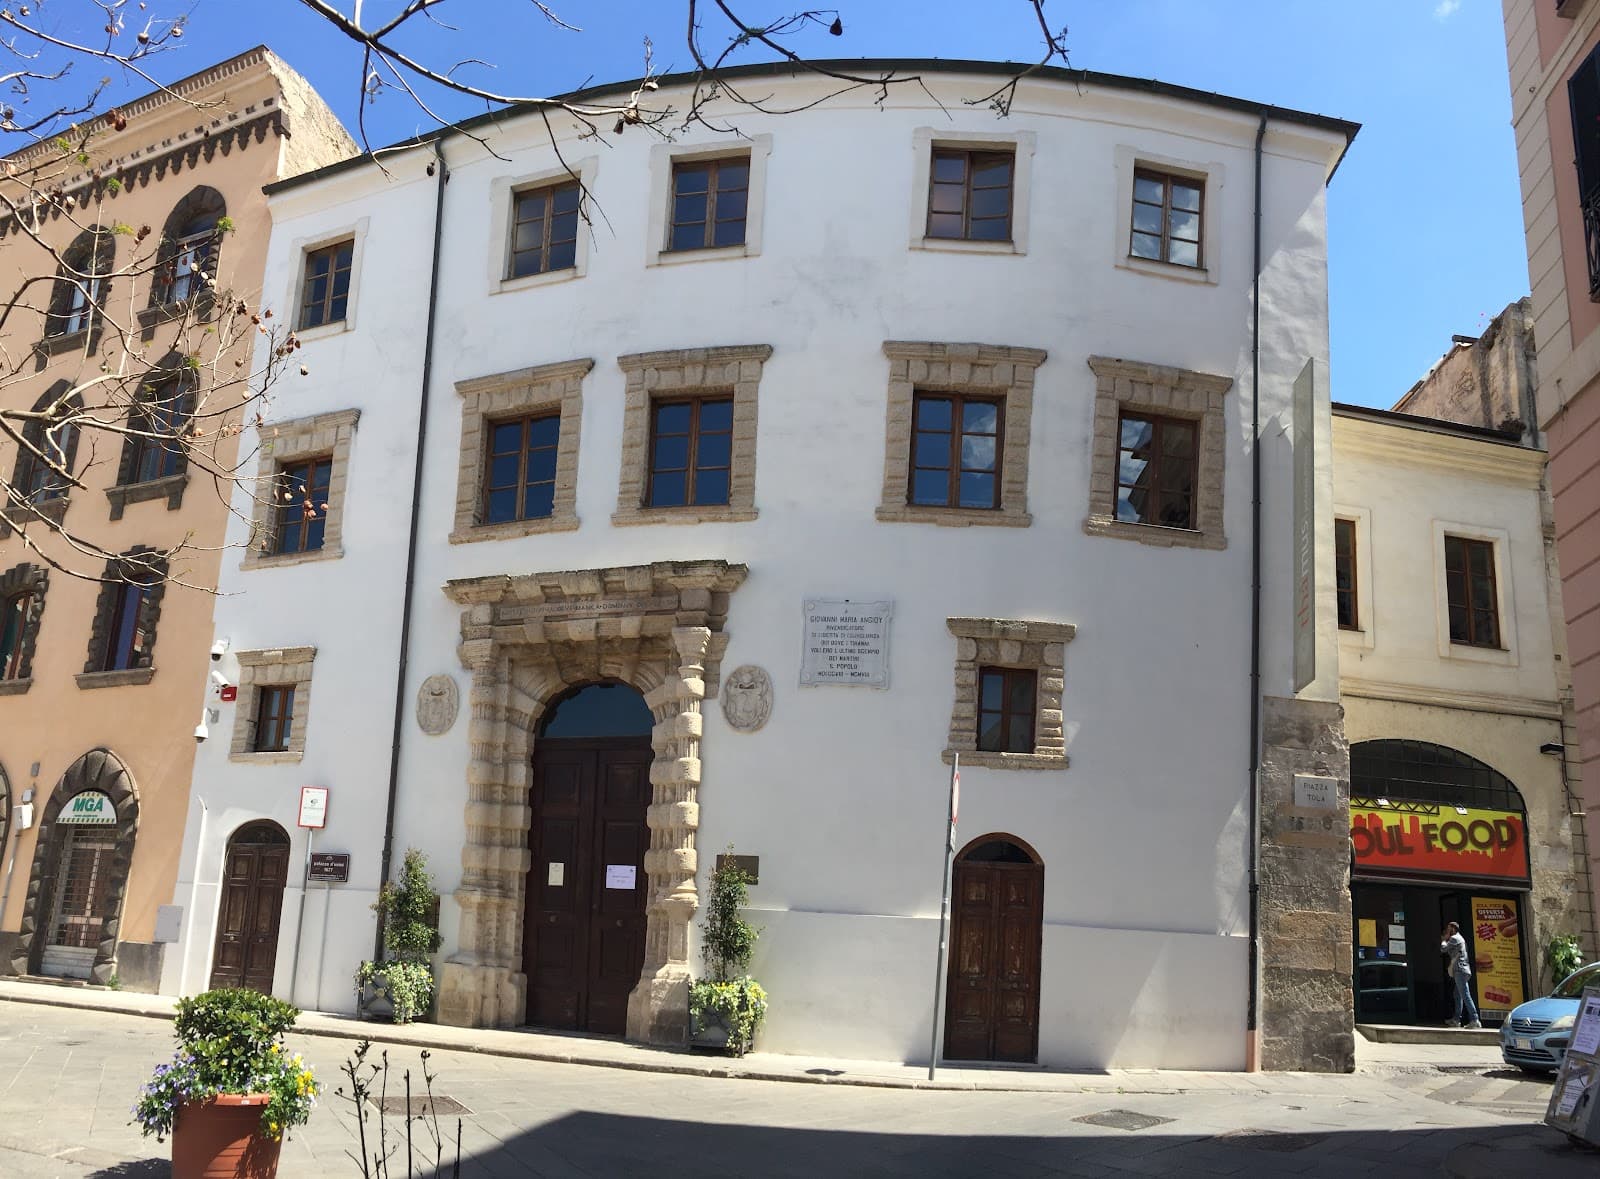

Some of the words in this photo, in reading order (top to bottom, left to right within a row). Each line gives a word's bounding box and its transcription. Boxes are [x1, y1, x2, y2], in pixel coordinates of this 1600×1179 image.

[810, 615, 838, 623] GIOVANNI
[860, 616, 883, 624] ANGIOY
[1303, 782, 1328, 790] PIAZZA
[73, 798, 103, 811] MGA
[1350, 825, 1414, 858] OUL
[1422, 818, 1518, 852] FOOD
